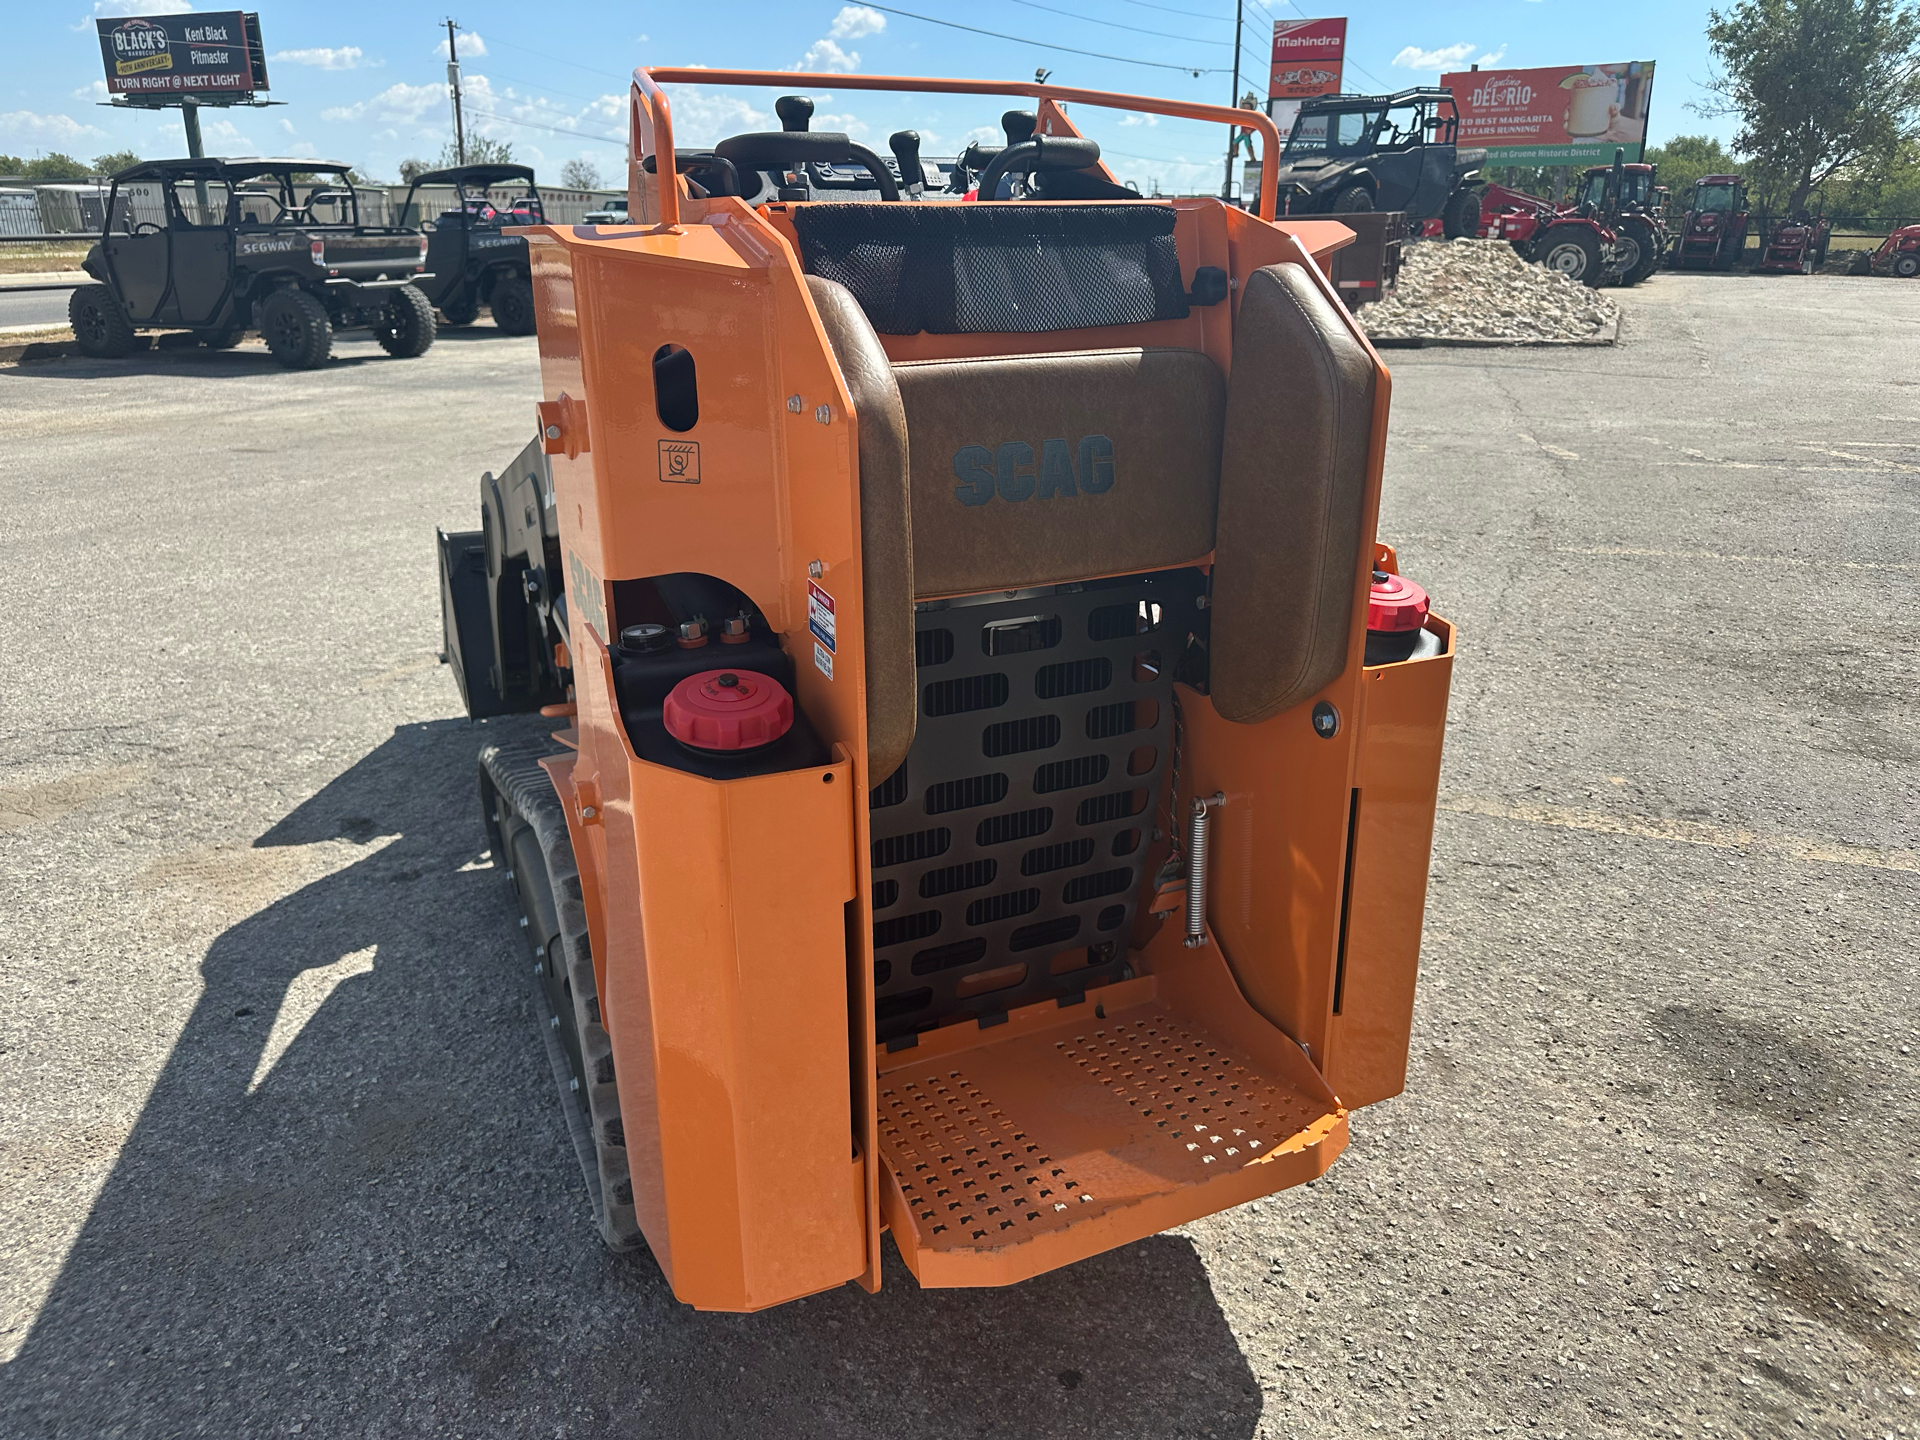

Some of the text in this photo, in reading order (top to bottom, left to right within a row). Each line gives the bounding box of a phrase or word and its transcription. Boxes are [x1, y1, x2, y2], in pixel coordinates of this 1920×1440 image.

[115, 31, 166, 51] BLACK'S
[185, 26, 228, 42] Kent Black
[1277, 36, 1340, 48] Mahindra
[134, 55, 168, 70] ANNIVERSARY
[190, 50, 229, 65] Pitmaster
[114, 74, 240, 89] TURN RIGHT @ NEXT LIGHT
[1485, 75, 1521, 92] Cantina
[1287, 86, 1323, 94] MOWERS
[1472, 86, 1531, 107] DEL RIO
[1475, 117, 1497, 125] BEST
[1499, 115, 1553, 124] MARGARITA
[1278, 127, 1327, 136] SEWAY
[1467, 127, 1495, 135] YEARS
[1497, 125, 1540, 134] RUNNING!
[1500, 150, 1508, 158] in
[1509, 150, 1536, 158] Gruene
[1538, 149, 1568, 157] Historic
[1570, 148, 1600, 157] District
[243, 240, 292, 253] SEGWAY
[478, 237, 521, 249] SEGWAY
[953, 434, 1115, 506] SCAG
[569, 549, 606, 641] SCAG
